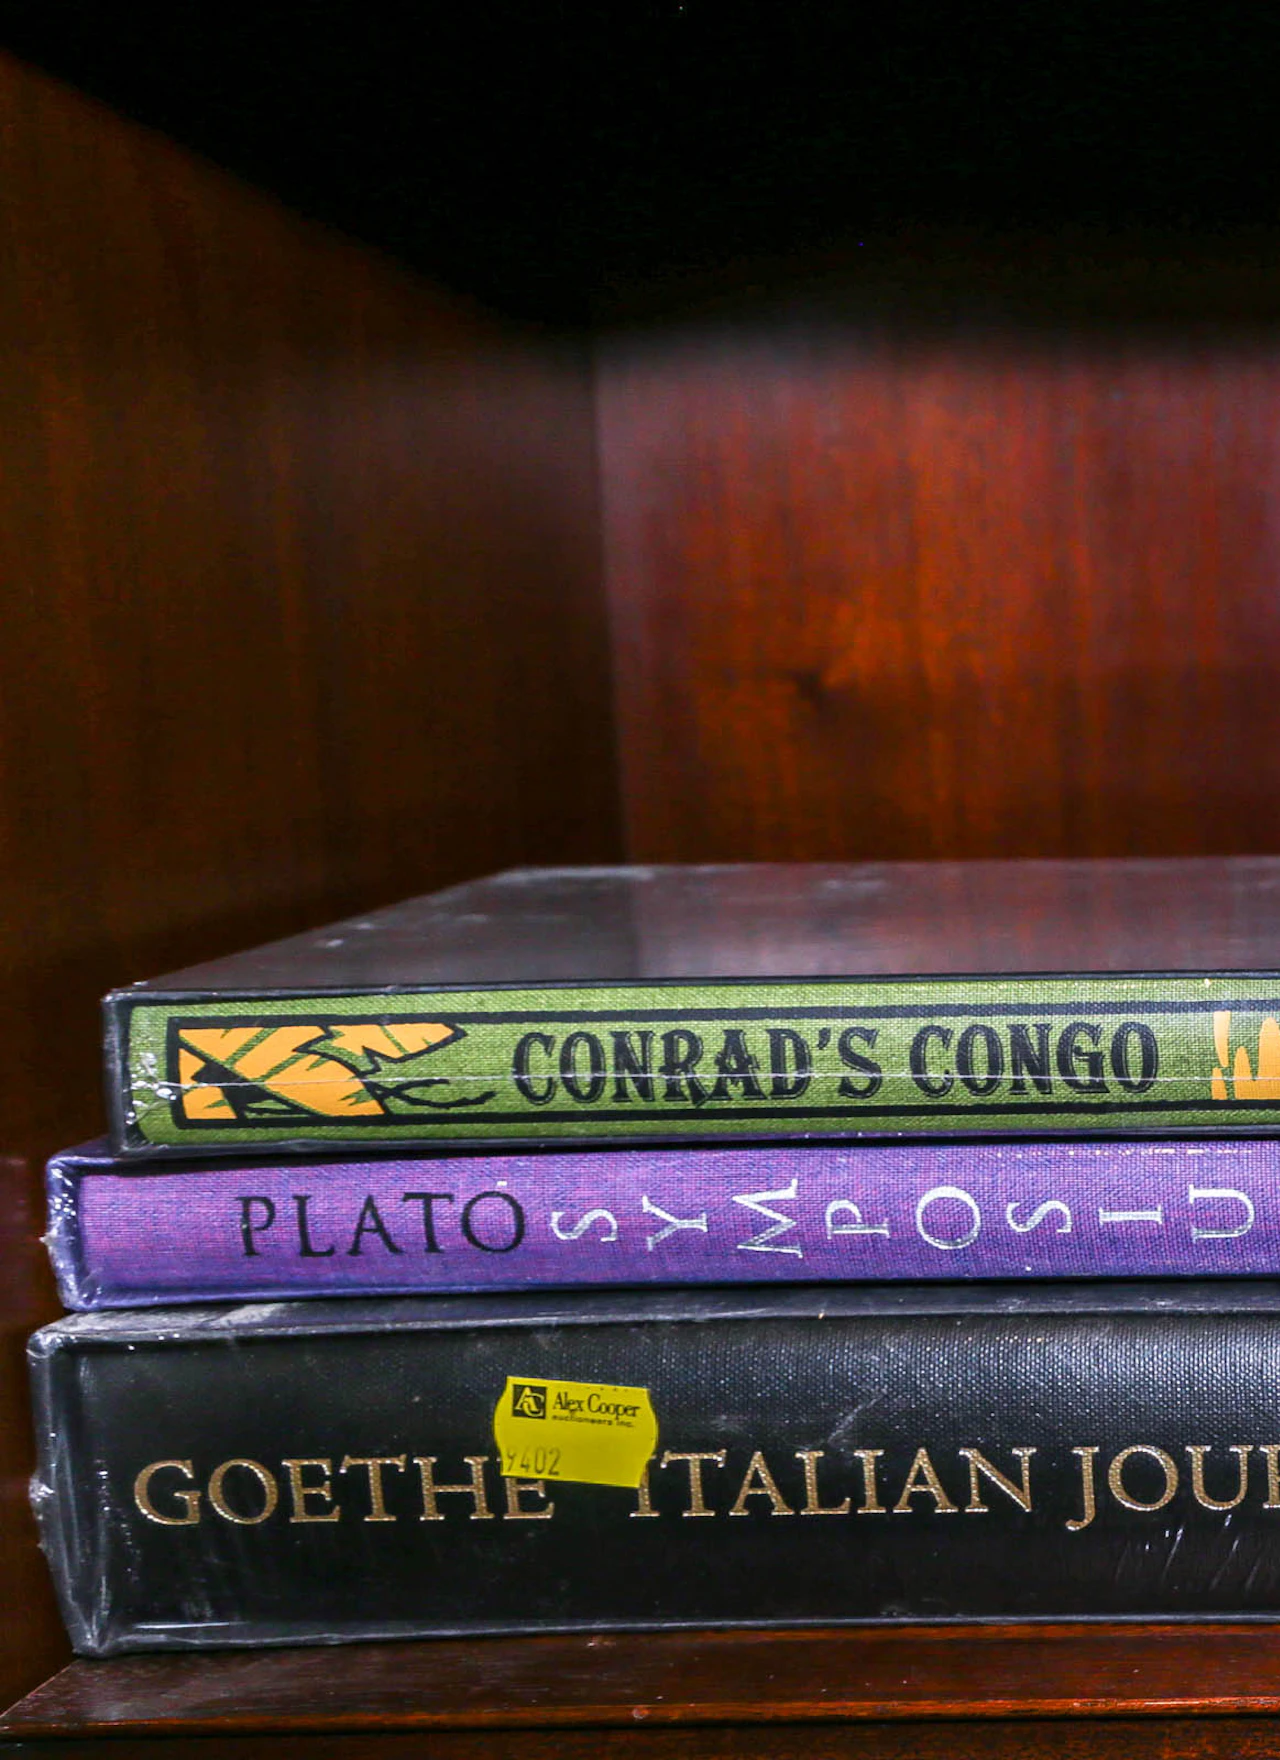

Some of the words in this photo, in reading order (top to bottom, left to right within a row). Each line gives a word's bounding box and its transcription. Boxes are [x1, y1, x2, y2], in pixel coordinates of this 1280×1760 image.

[512, 1026, 882, 1106] CONRAD'S
[909, 1021, 1160, 1095] CONGO
[233, 1189, 526, 1258] PLATO
[553, 1391, 584, 1414] Alex
[587, 1393, 642, 1420] Cooper
[133, 1454, 556, 1525] GOETHE
[629, 1446, 1038, 1519] ITALIAN
